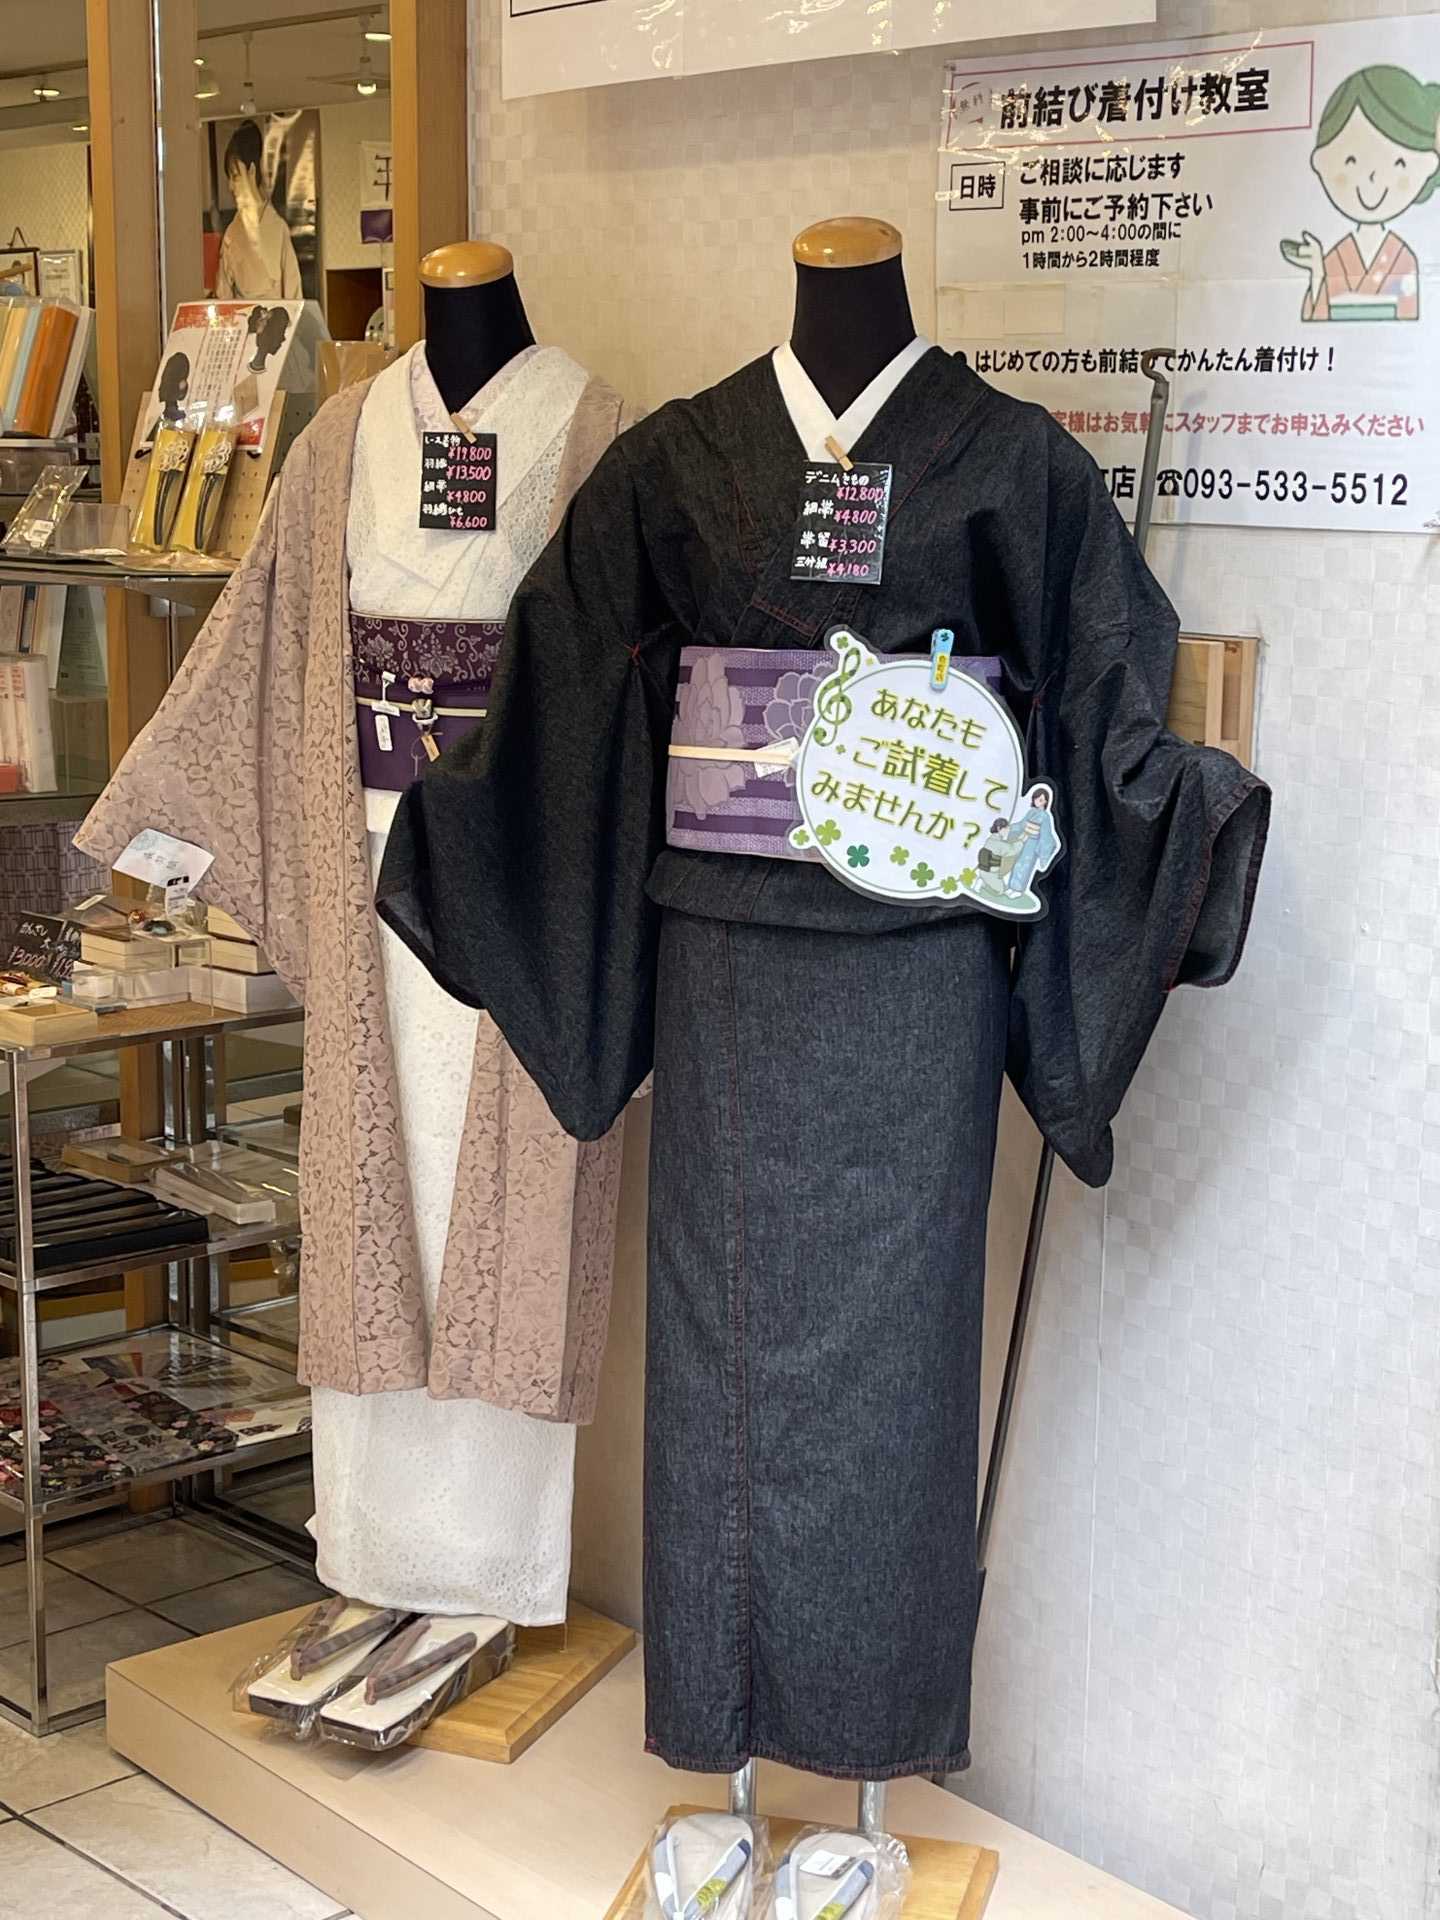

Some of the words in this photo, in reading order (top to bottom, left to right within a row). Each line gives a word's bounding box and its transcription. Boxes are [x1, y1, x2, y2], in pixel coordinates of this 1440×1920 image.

[1000, 67, 1269, 129] 前結び着付け教室
[1020, 152, 1185, 187] ご相談に応じます
[960, 174, 996, 200] 日時
[1019, 193, 1214, 225] 事前にご予約下さい
[1021, 230, 1045, 246] pm
[1022, 248, 1160, 270] 1時間から2時間程度
[804, 470, 870, 486] デニムきもの
[1184, 468, 1408, 506] 093-533-5512
[870, 688, 988, 750] あなたも
[852, 736, 1009, 812] ご試着して
